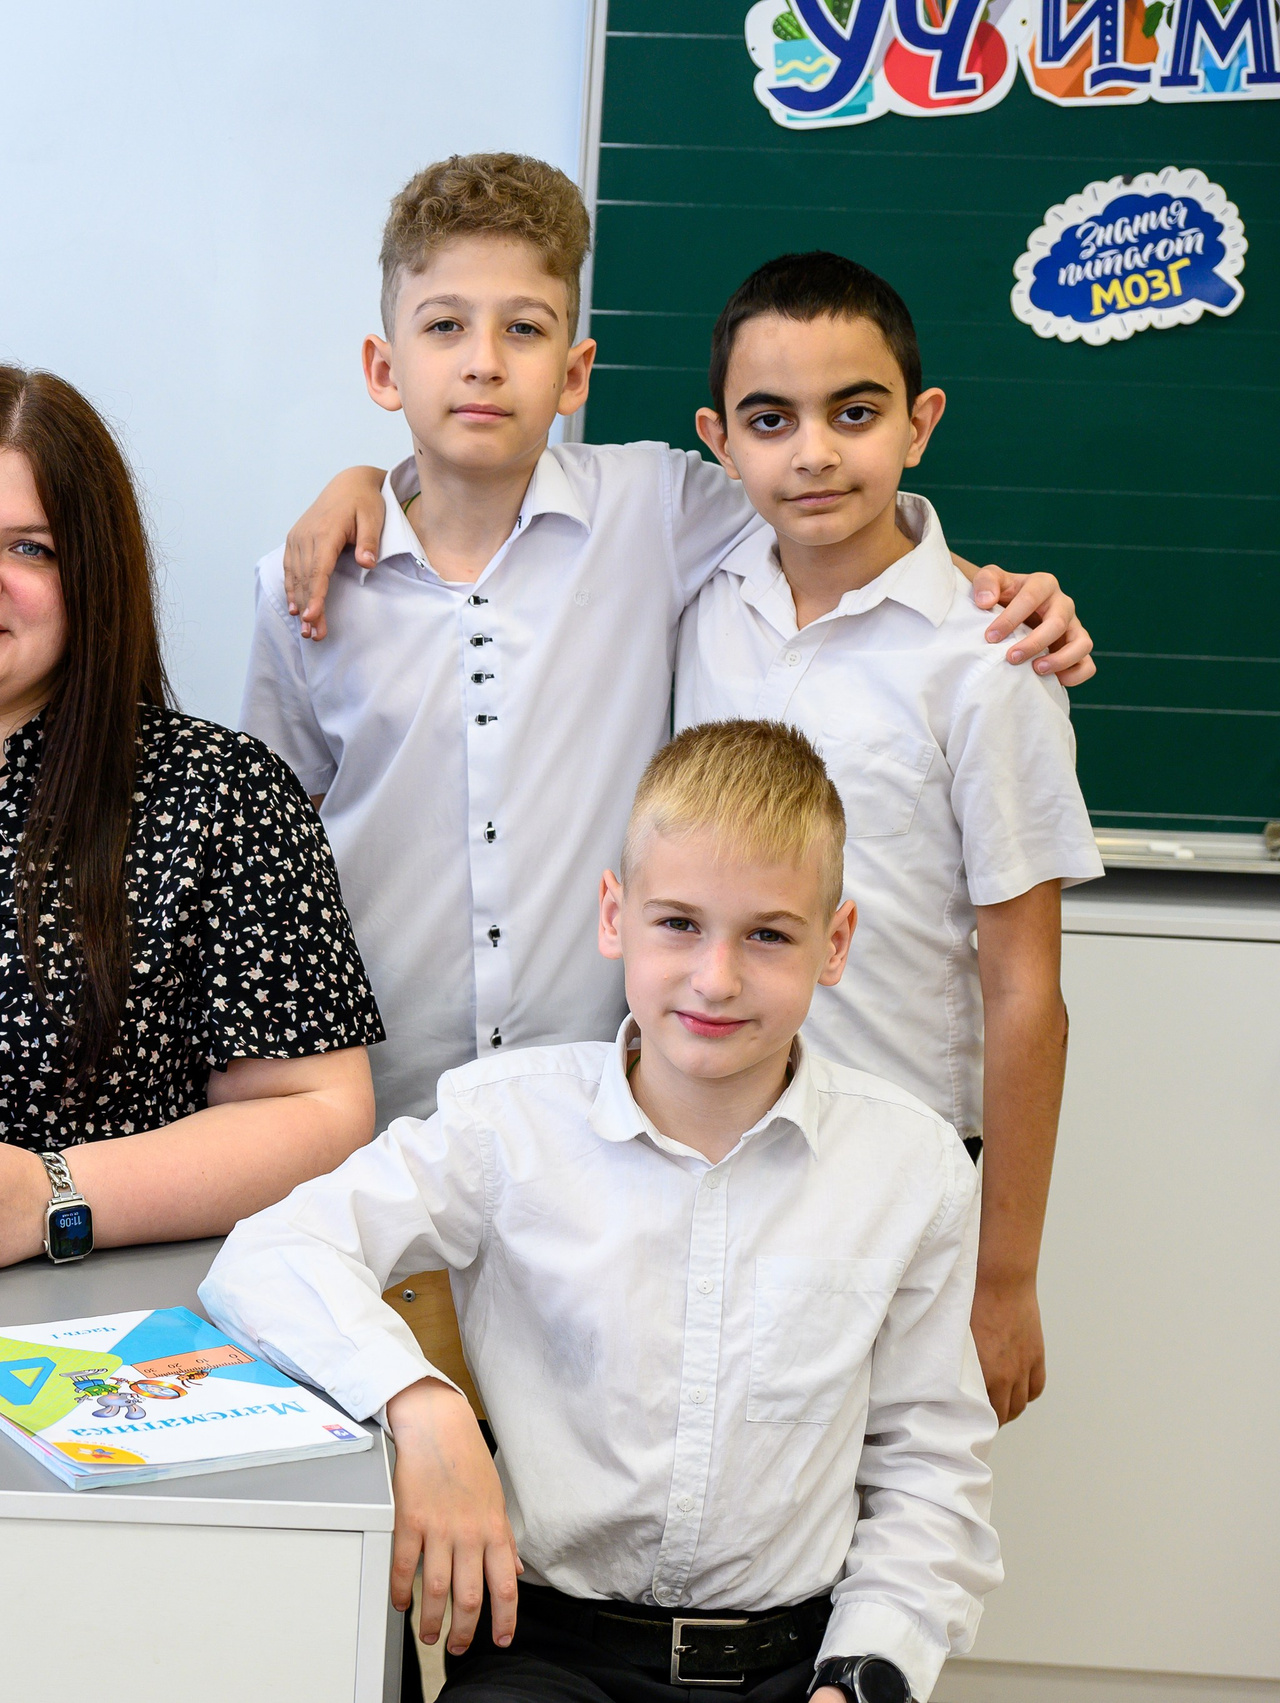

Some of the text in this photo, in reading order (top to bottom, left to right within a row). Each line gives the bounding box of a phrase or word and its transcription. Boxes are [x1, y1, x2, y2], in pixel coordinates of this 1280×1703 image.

[1075, 200, 1188, 260] Знания
[1058, 227, 1205, 287] питают
[1090, 257, 1191, 316] МОЗГ
[59, 1215, 82, 1229] 11:06
[63, 1326, 117, 1338] Часть
[167, 1361, 182, 1370] 20
[195, 1357, 210, 1365] 10
[143, 1366, 158, 1374] 30
[67, 1400, 311, 1438] Математика
